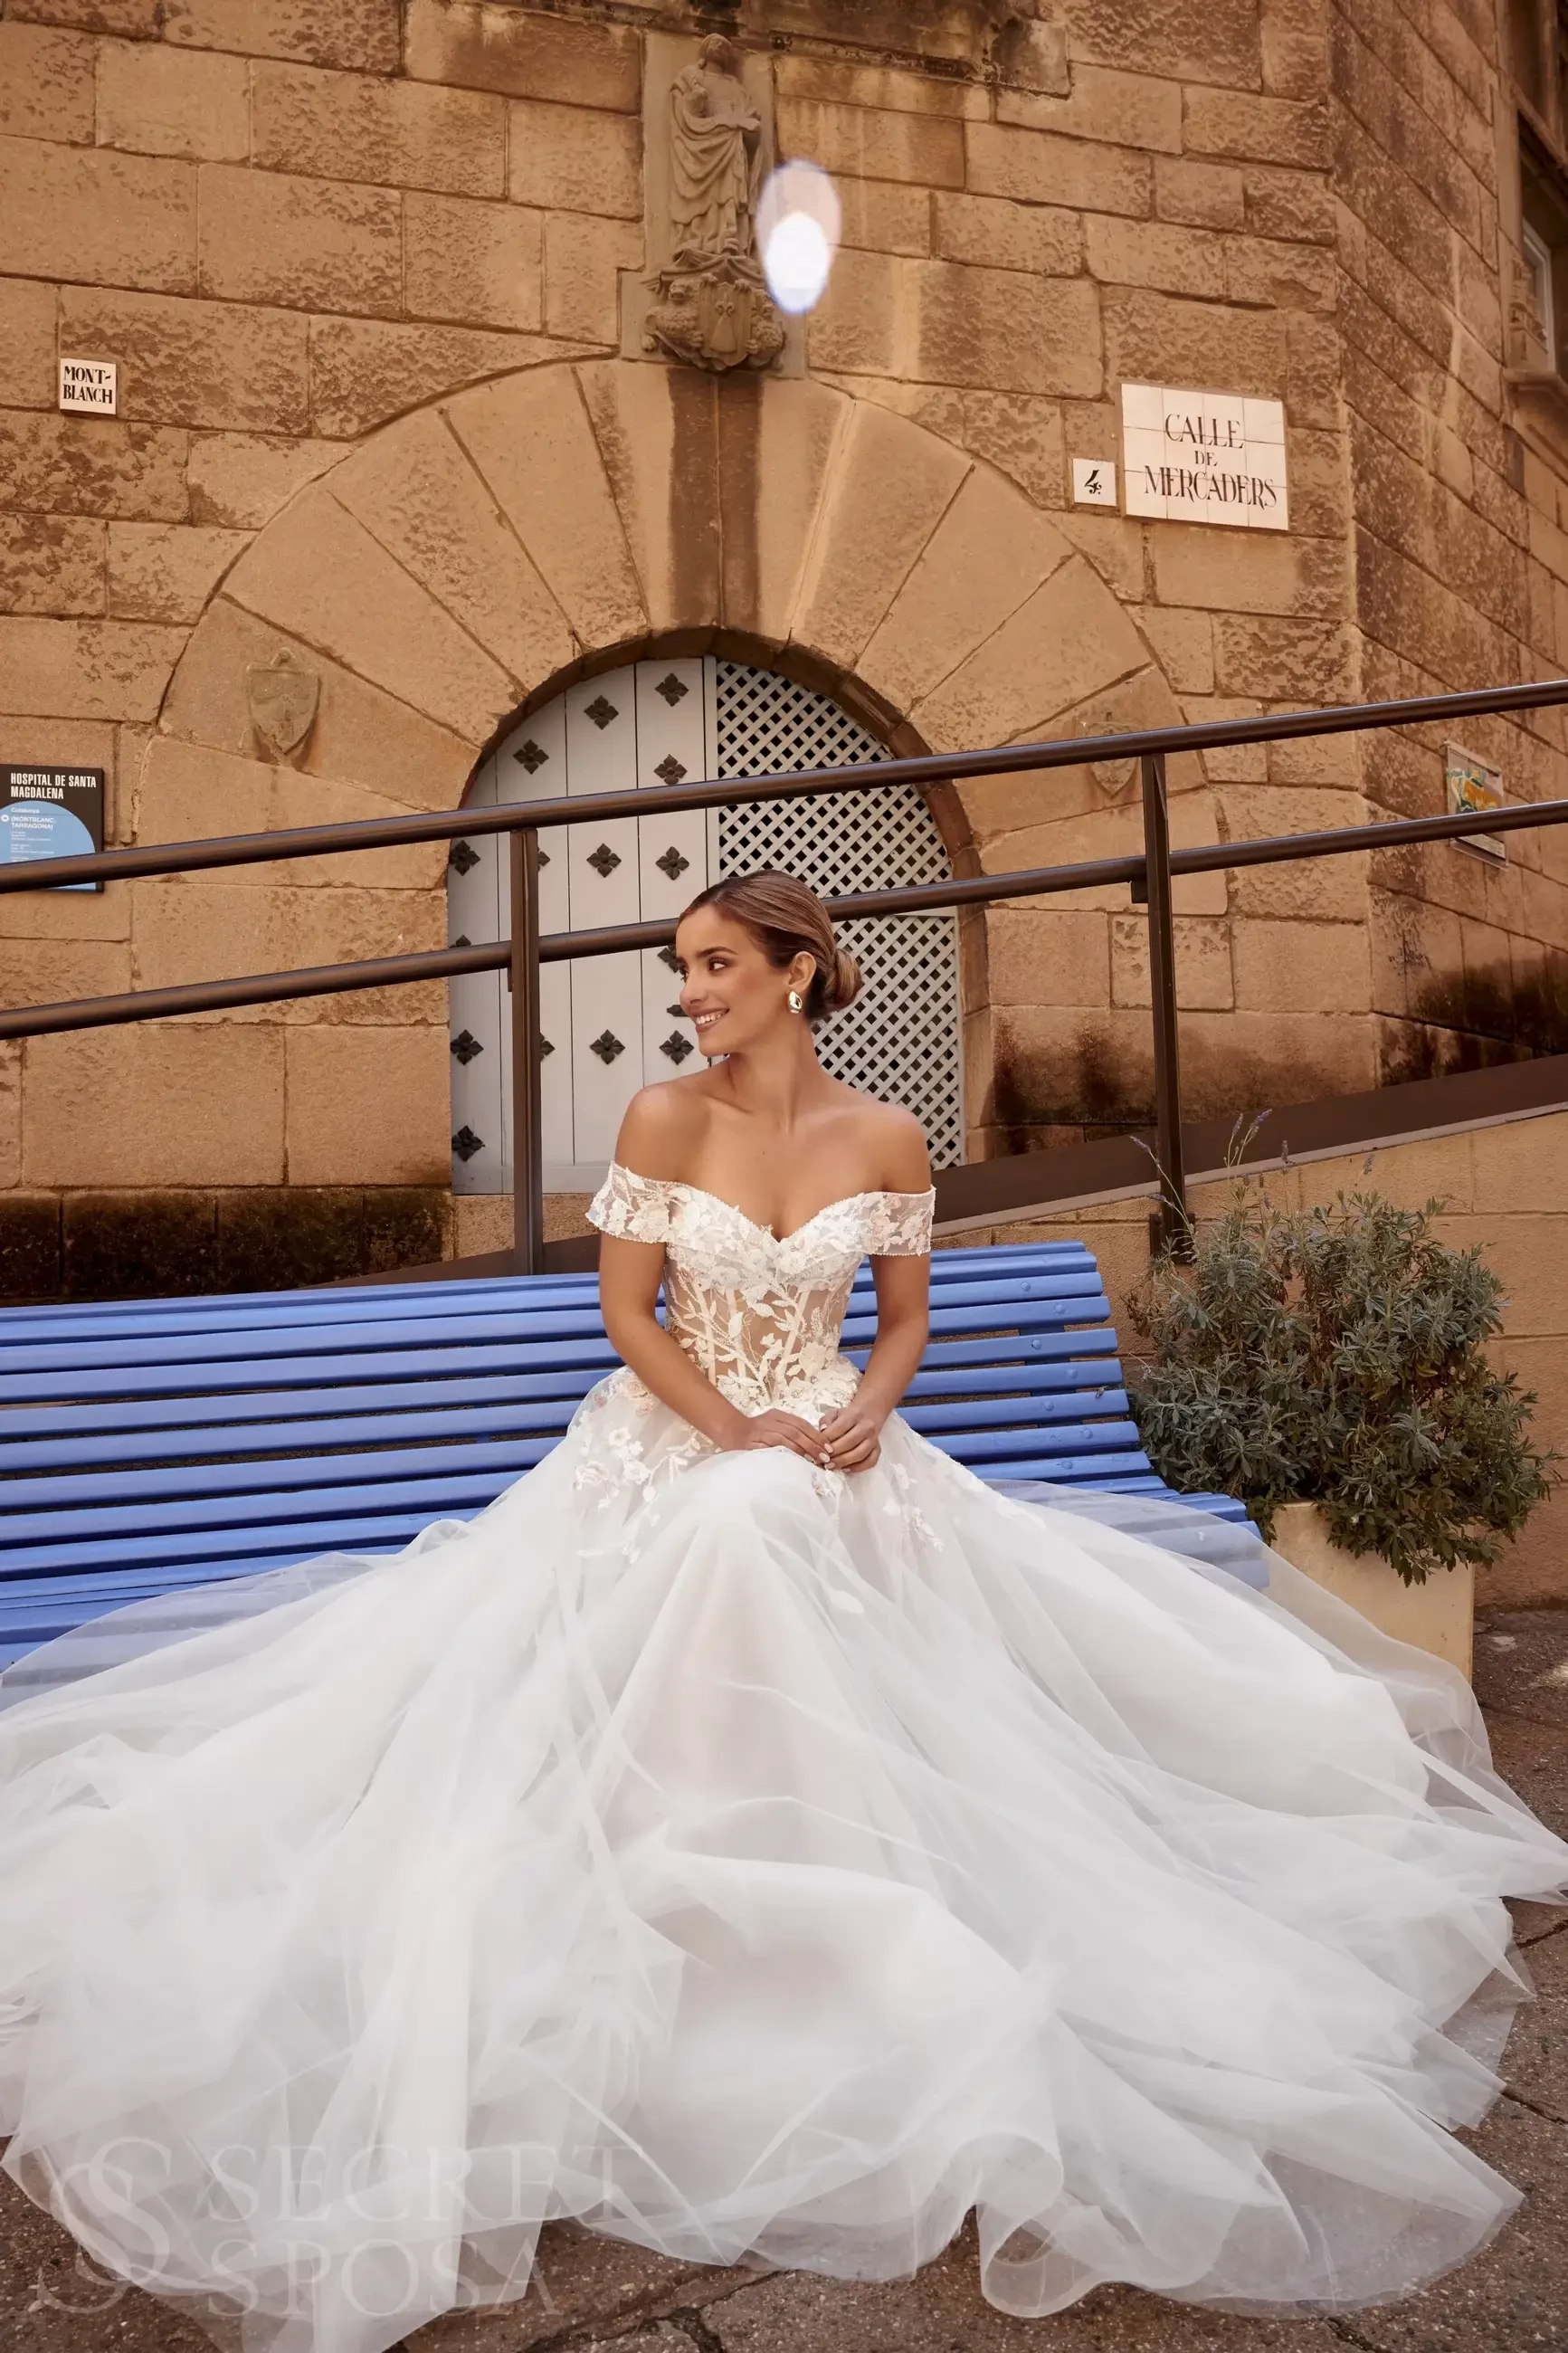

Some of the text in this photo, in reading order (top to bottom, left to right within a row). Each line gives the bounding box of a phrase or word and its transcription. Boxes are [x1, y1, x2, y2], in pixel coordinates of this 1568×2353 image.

[63, 366, 111, 385] MONT-
[62, 384, 113, 404] BLANCH
[1164, 413, 1244, 449] CALLE
[1194, 450, 1218, 467] DE
[1144, 465, 1278, 510] MERCADERS
[11, 773, 97, 787] HOSPITAL DE SANTA
[11, 786, 63, 799] MAGDALENA
